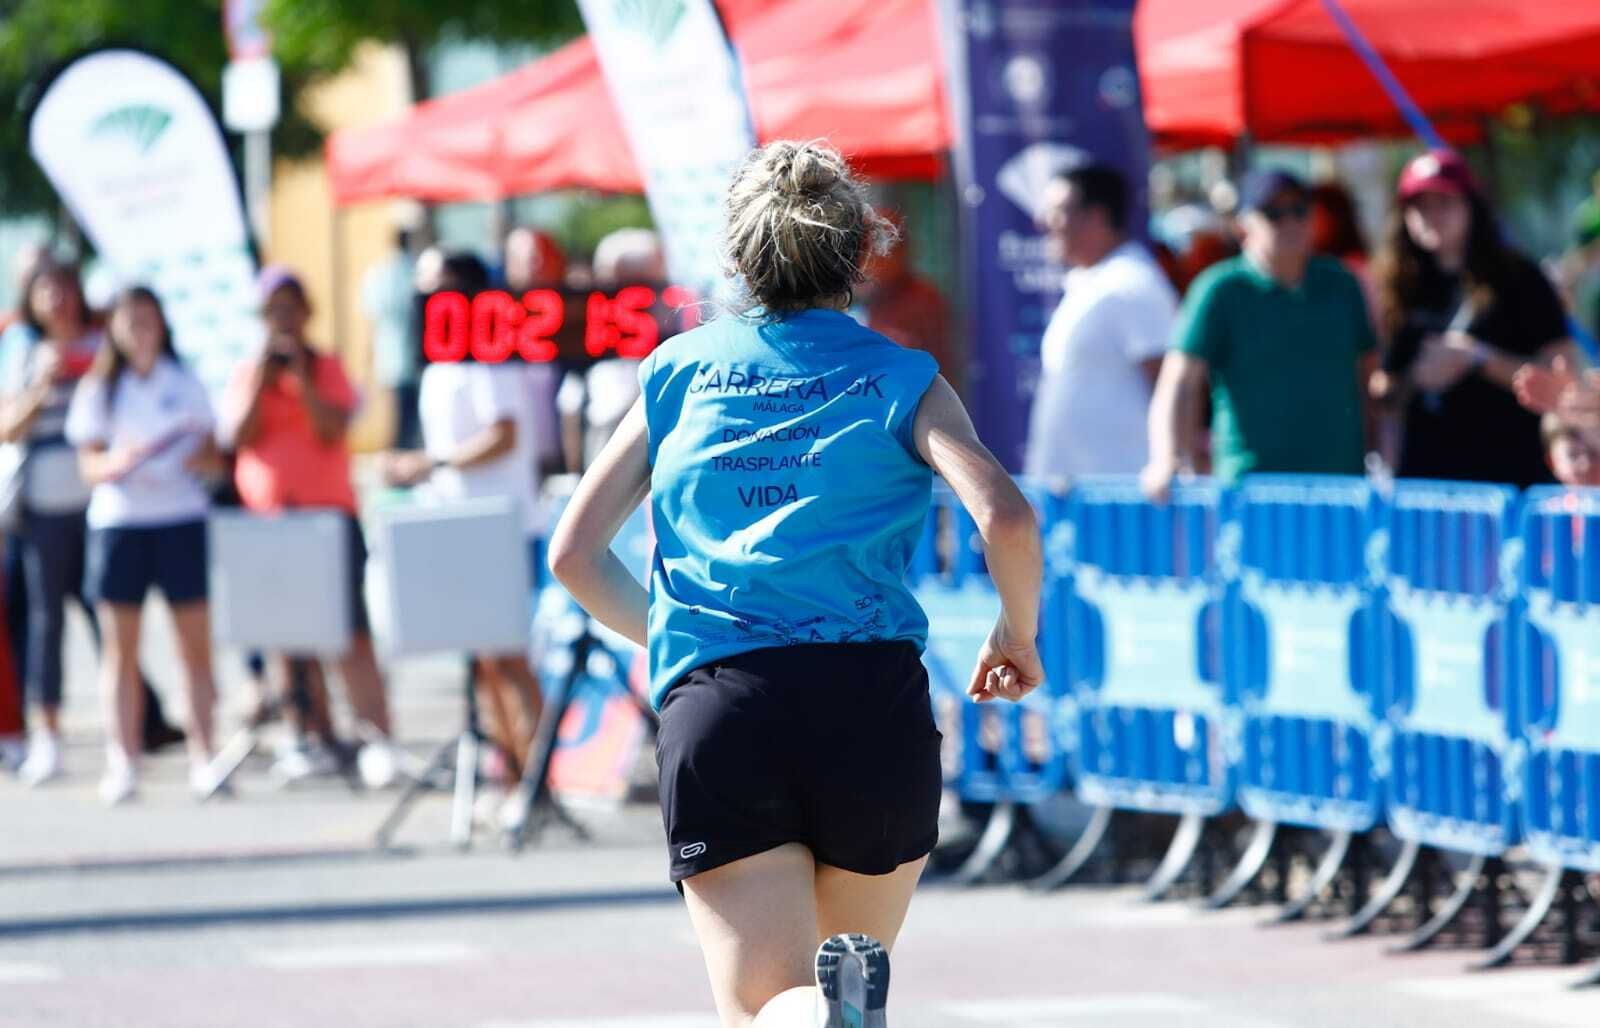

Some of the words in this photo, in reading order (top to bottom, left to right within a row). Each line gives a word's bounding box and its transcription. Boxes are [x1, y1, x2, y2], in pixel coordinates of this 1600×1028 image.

[752, 398, 805, 414] MÁLAGA
[723, 425, 820, 444] DONACIÓN
[711, 452, 822, 472] TRASPLANTE
[737, 483, 799, 508] VIDA
